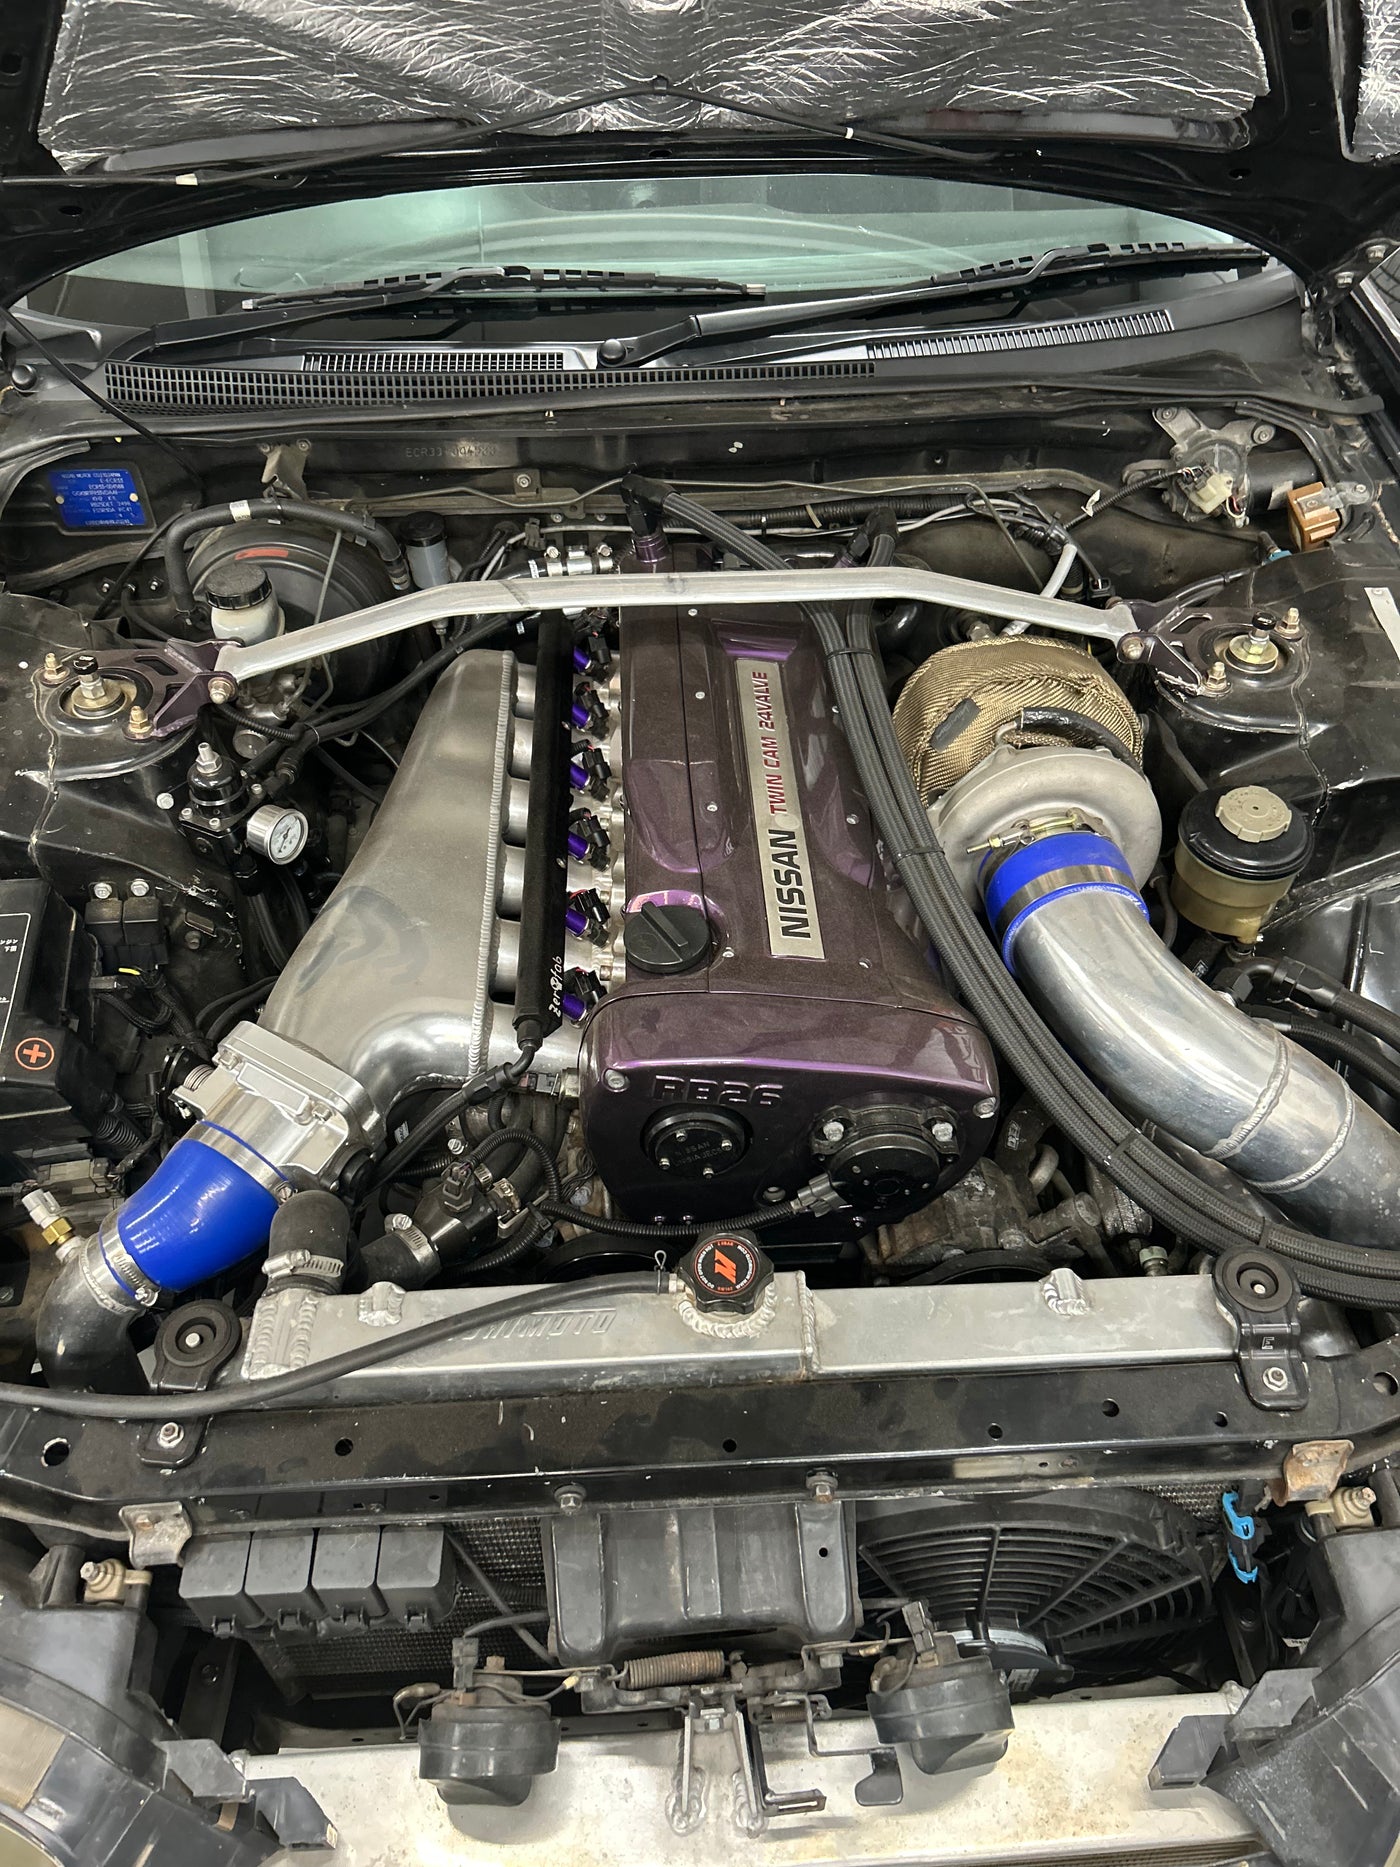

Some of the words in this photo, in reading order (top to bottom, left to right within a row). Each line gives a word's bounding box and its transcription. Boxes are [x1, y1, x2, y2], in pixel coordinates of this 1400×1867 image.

[752, 670, 775, 732] 24VALVE
[760, 736, 781, 770] CAM
[766, 773, 788, 815] TWIN
[767, 828, 811, 939] NISSAN
